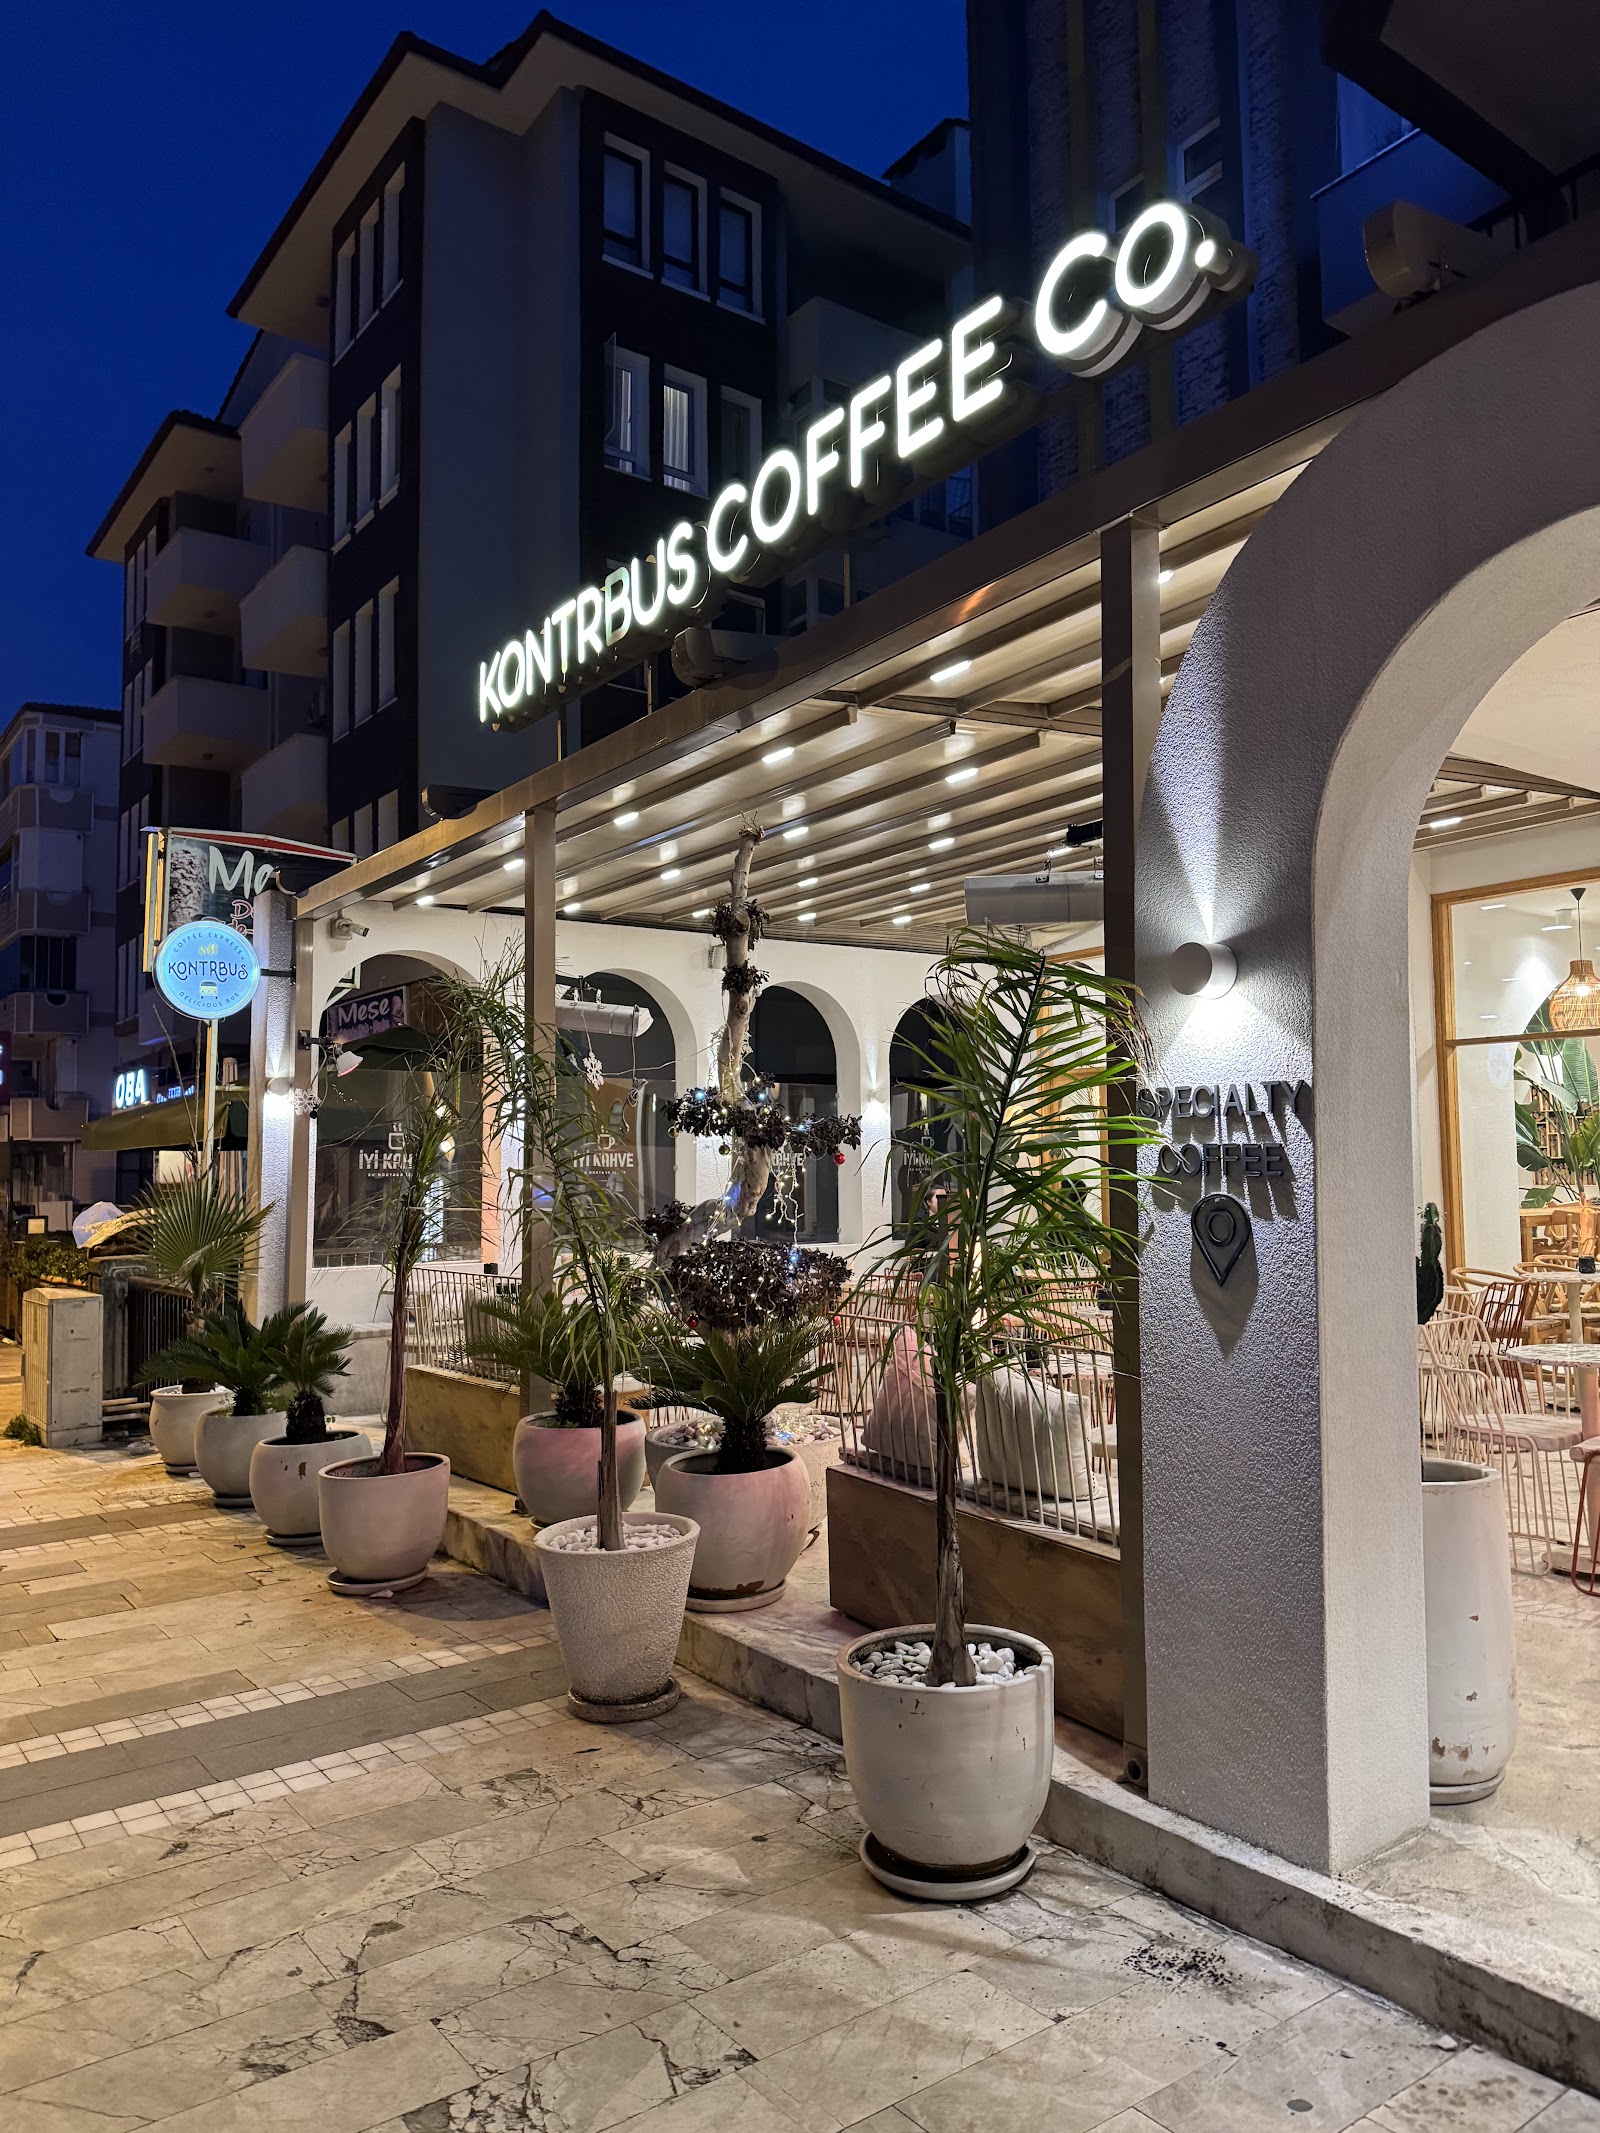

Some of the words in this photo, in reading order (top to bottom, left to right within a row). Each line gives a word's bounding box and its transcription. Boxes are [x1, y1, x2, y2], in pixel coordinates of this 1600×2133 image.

[479, 521, 697, 724] KONTRBUS
[706, 294, 1003, 573] COFFEE
[1034, 201, 1217, 355] CO.
[173, 932, 203, 953] COFFEE
[208, 932, 242, 955] EXPRESS
[168, 960, 249, 983] KONTRBUS
[179, 991, 223, 1008] DELICIOUS
[226, 992, 240, 1004] BUS
[337, 997, 390, 1027] Mese
[115, 1068, 146, 1108] OBA
[1138, 1080, 1304, 1118] SPECIALTY
[593, 1151, 634, 1168] KAHVE
[1159, 1143, 1284, 1177] COFFEE
